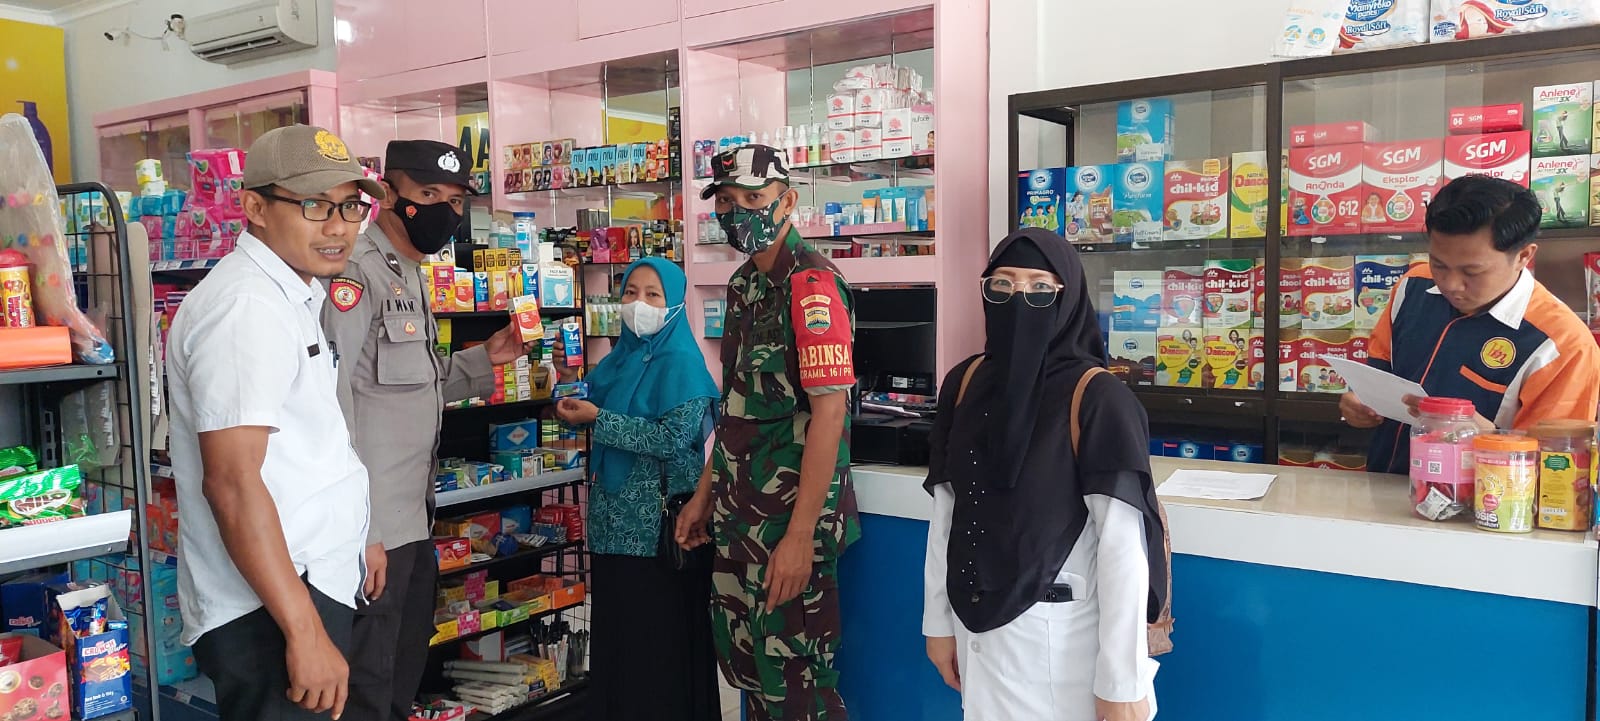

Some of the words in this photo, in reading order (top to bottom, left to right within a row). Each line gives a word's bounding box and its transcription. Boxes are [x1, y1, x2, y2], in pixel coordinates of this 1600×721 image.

[1496, 7, 1521, 19] Royal
[1540, 88, 1576, 98] Anlene
[1383, 146, 1421, 166] SGM
[1465, 139, 1506, 161] SGM
[1308, 152, 1341, 170] SGM
[1537, 160, 1573, 170] Anlene
[1382, 176, 1420, 185] Eksplor
[829, 367, 838, 377] 16
[15, 492, 67, 512] MILO
[83, 640, 116, 656] CRUNCH
